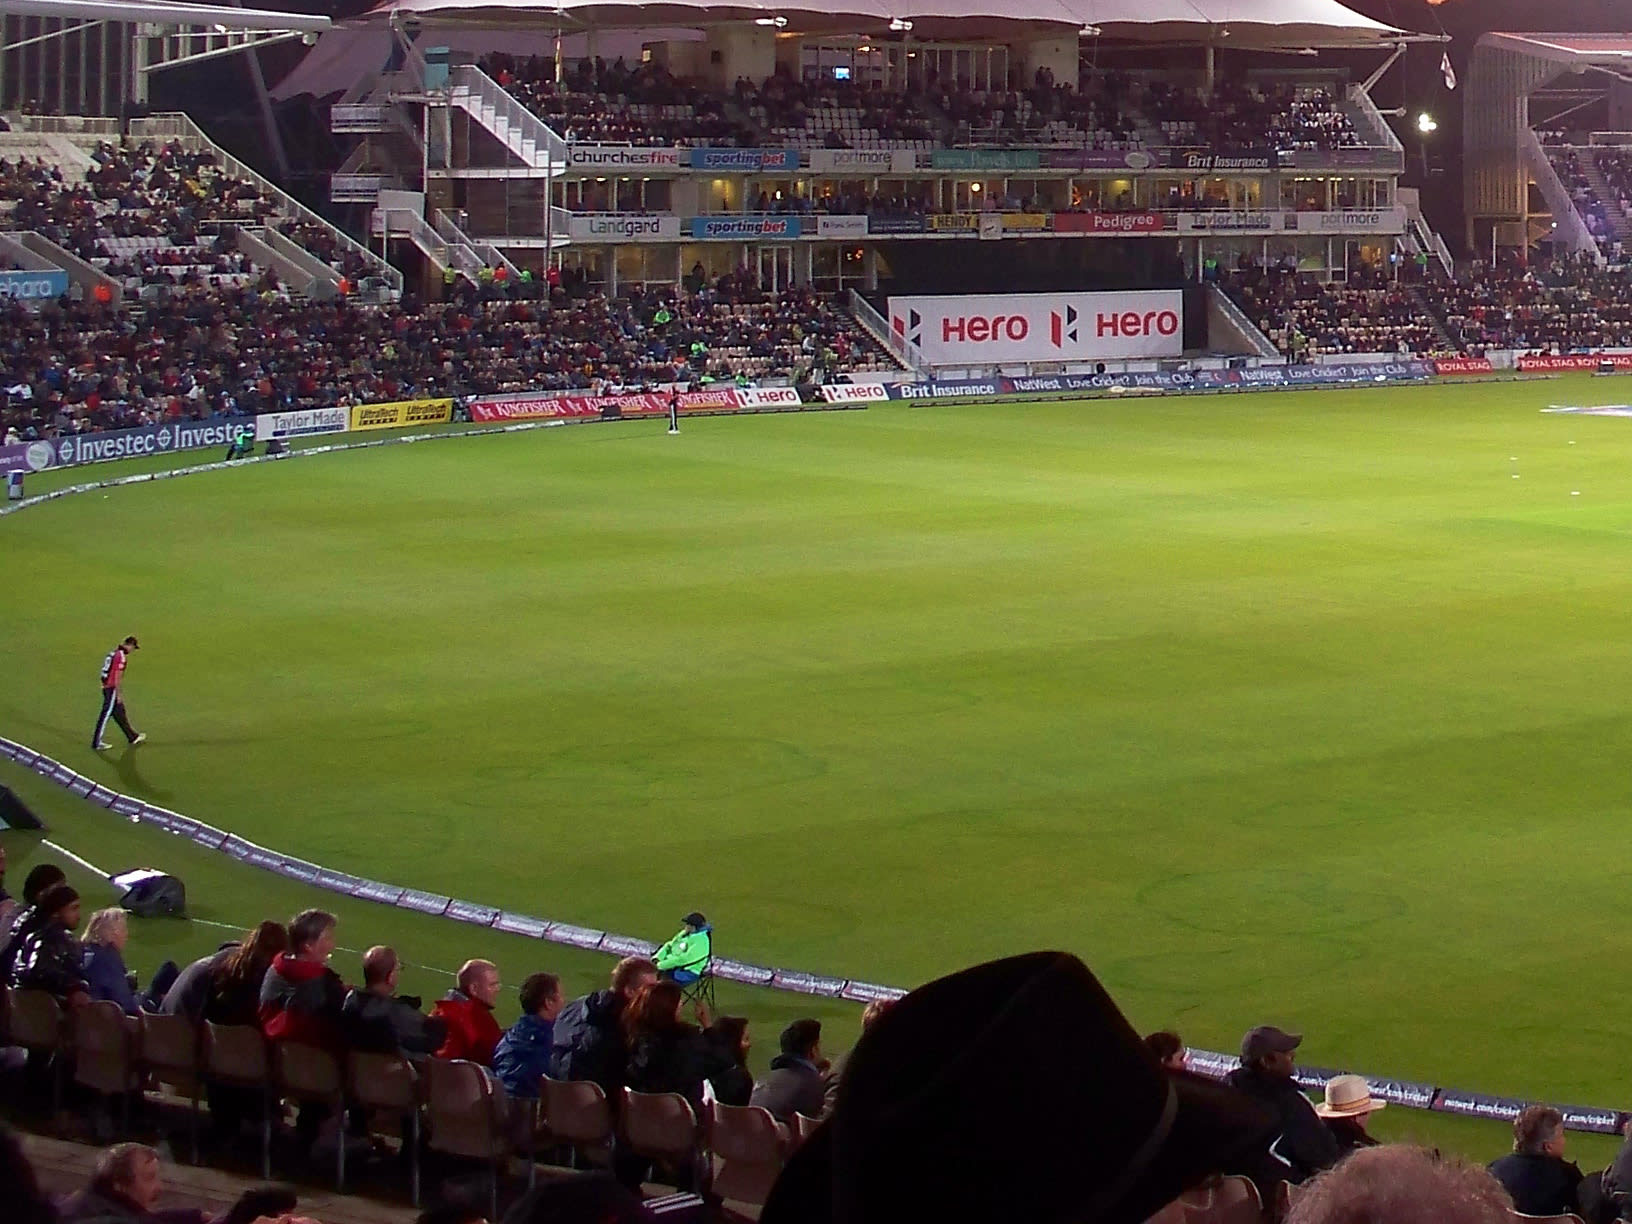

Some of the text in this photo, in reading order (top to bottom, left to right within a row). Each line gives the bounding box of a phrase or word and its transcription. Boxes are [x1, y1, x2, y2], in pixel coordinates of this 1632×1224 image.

[706, 150, 786, 166] sportingbet
[1187, 154, 1268, 168] Brit Insurance
[589, 218, 660, 237] Landgard
[706, 219, 787, 234] sportingbet
[1094, 214, 1154, 230] Pedigree
[942, 310, 1179, 343] Hero Hero
[1369, 365, 1385, 376] the
[1386, 363, 1407, 375] Club
[1438, 360, 1491, 371] ROYAL STAG
[1521, 357, 1550, 368] ROYAL
[1551, 357, 1575, 367] STAG
[1012, 378, 1062, 392] NatWest
[1154, 374, 1171, 385] the
[1172, 373, 1195, 384] Club
[758, 387, 797, 403] Hero
[849, 383, 884, 398] Hero
[901, 382, 995, 398] Brit Insurance
[272, 413, 310, 432] Taylor
[313, 410, 345, 425] Made
[76, 433, 155, 462] Investec
